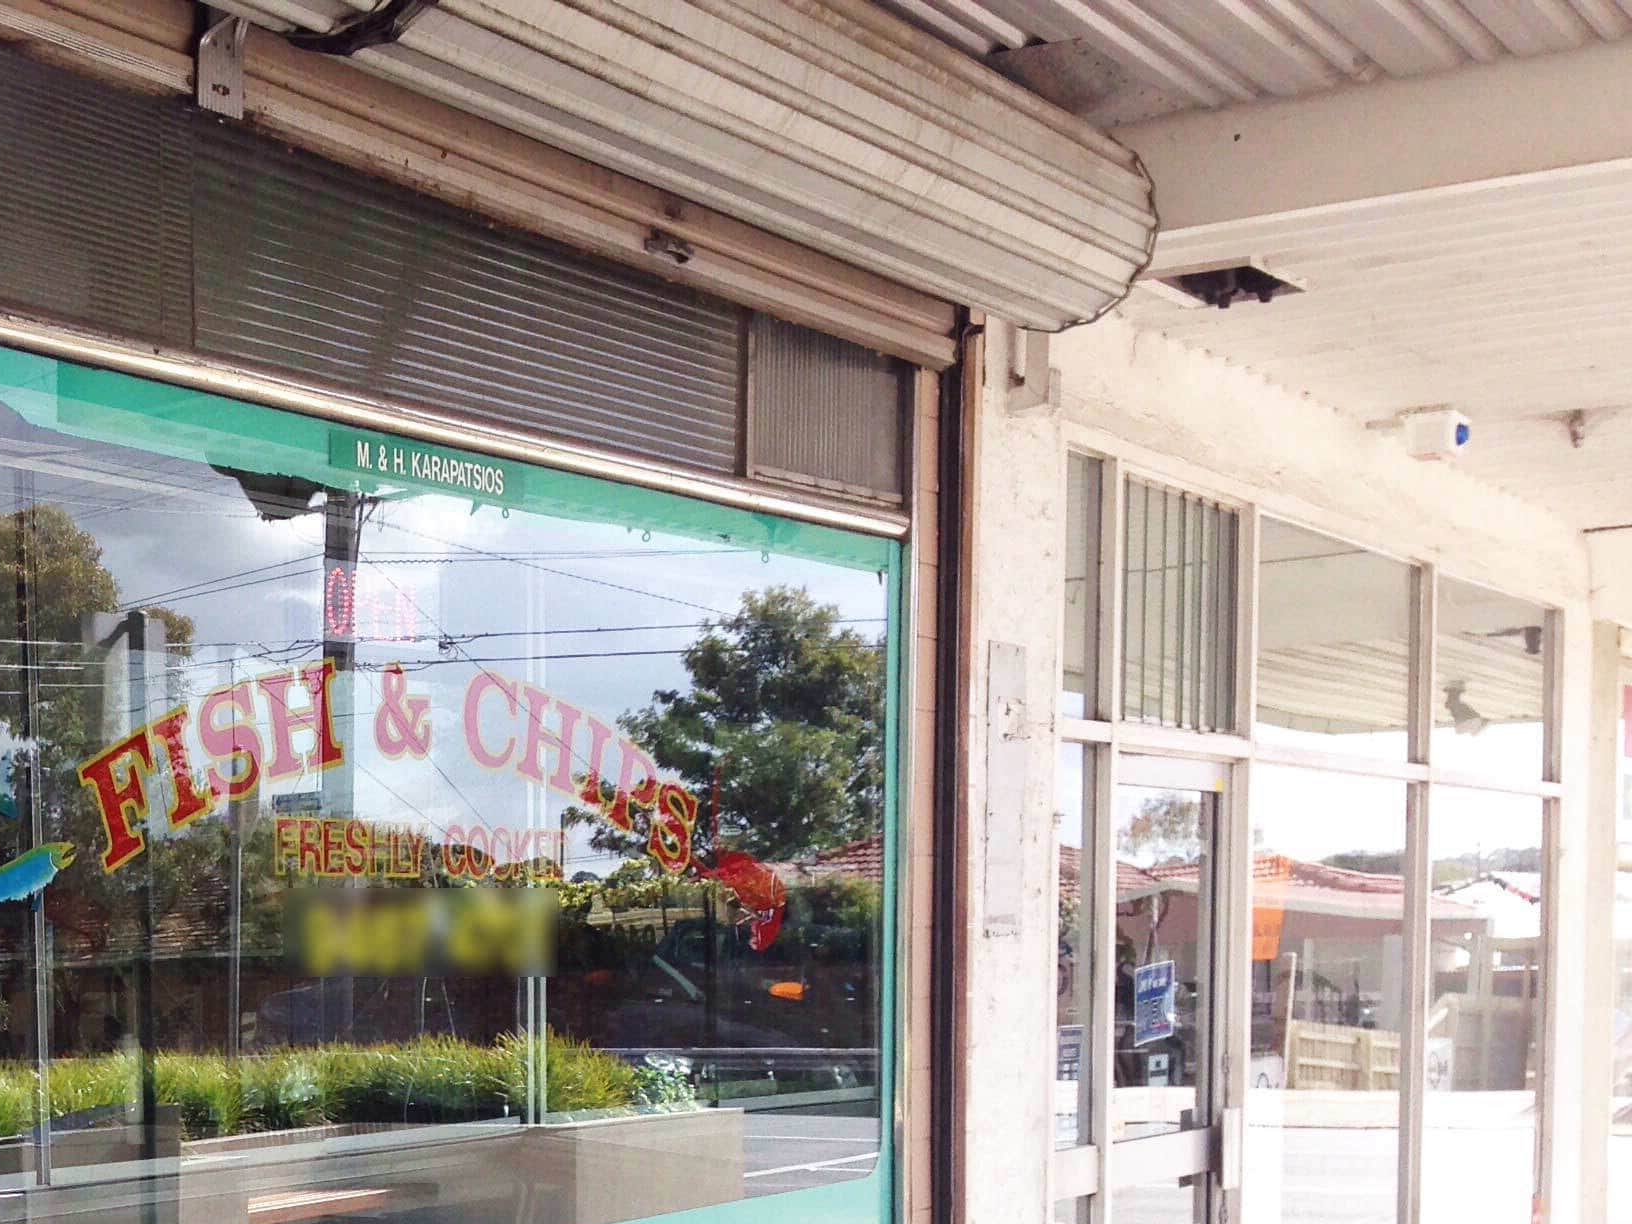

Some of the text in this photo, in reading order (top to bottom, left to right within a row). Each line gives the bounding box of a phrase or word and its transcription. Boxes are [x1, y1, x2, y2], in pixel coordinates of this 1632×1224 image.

[357, 440, 504, 495] M. & H. KARAPATSIOS
[77, 656, 698, 875] FISH & CHIPS
[274, 816, 431, 881] FRESHLY
